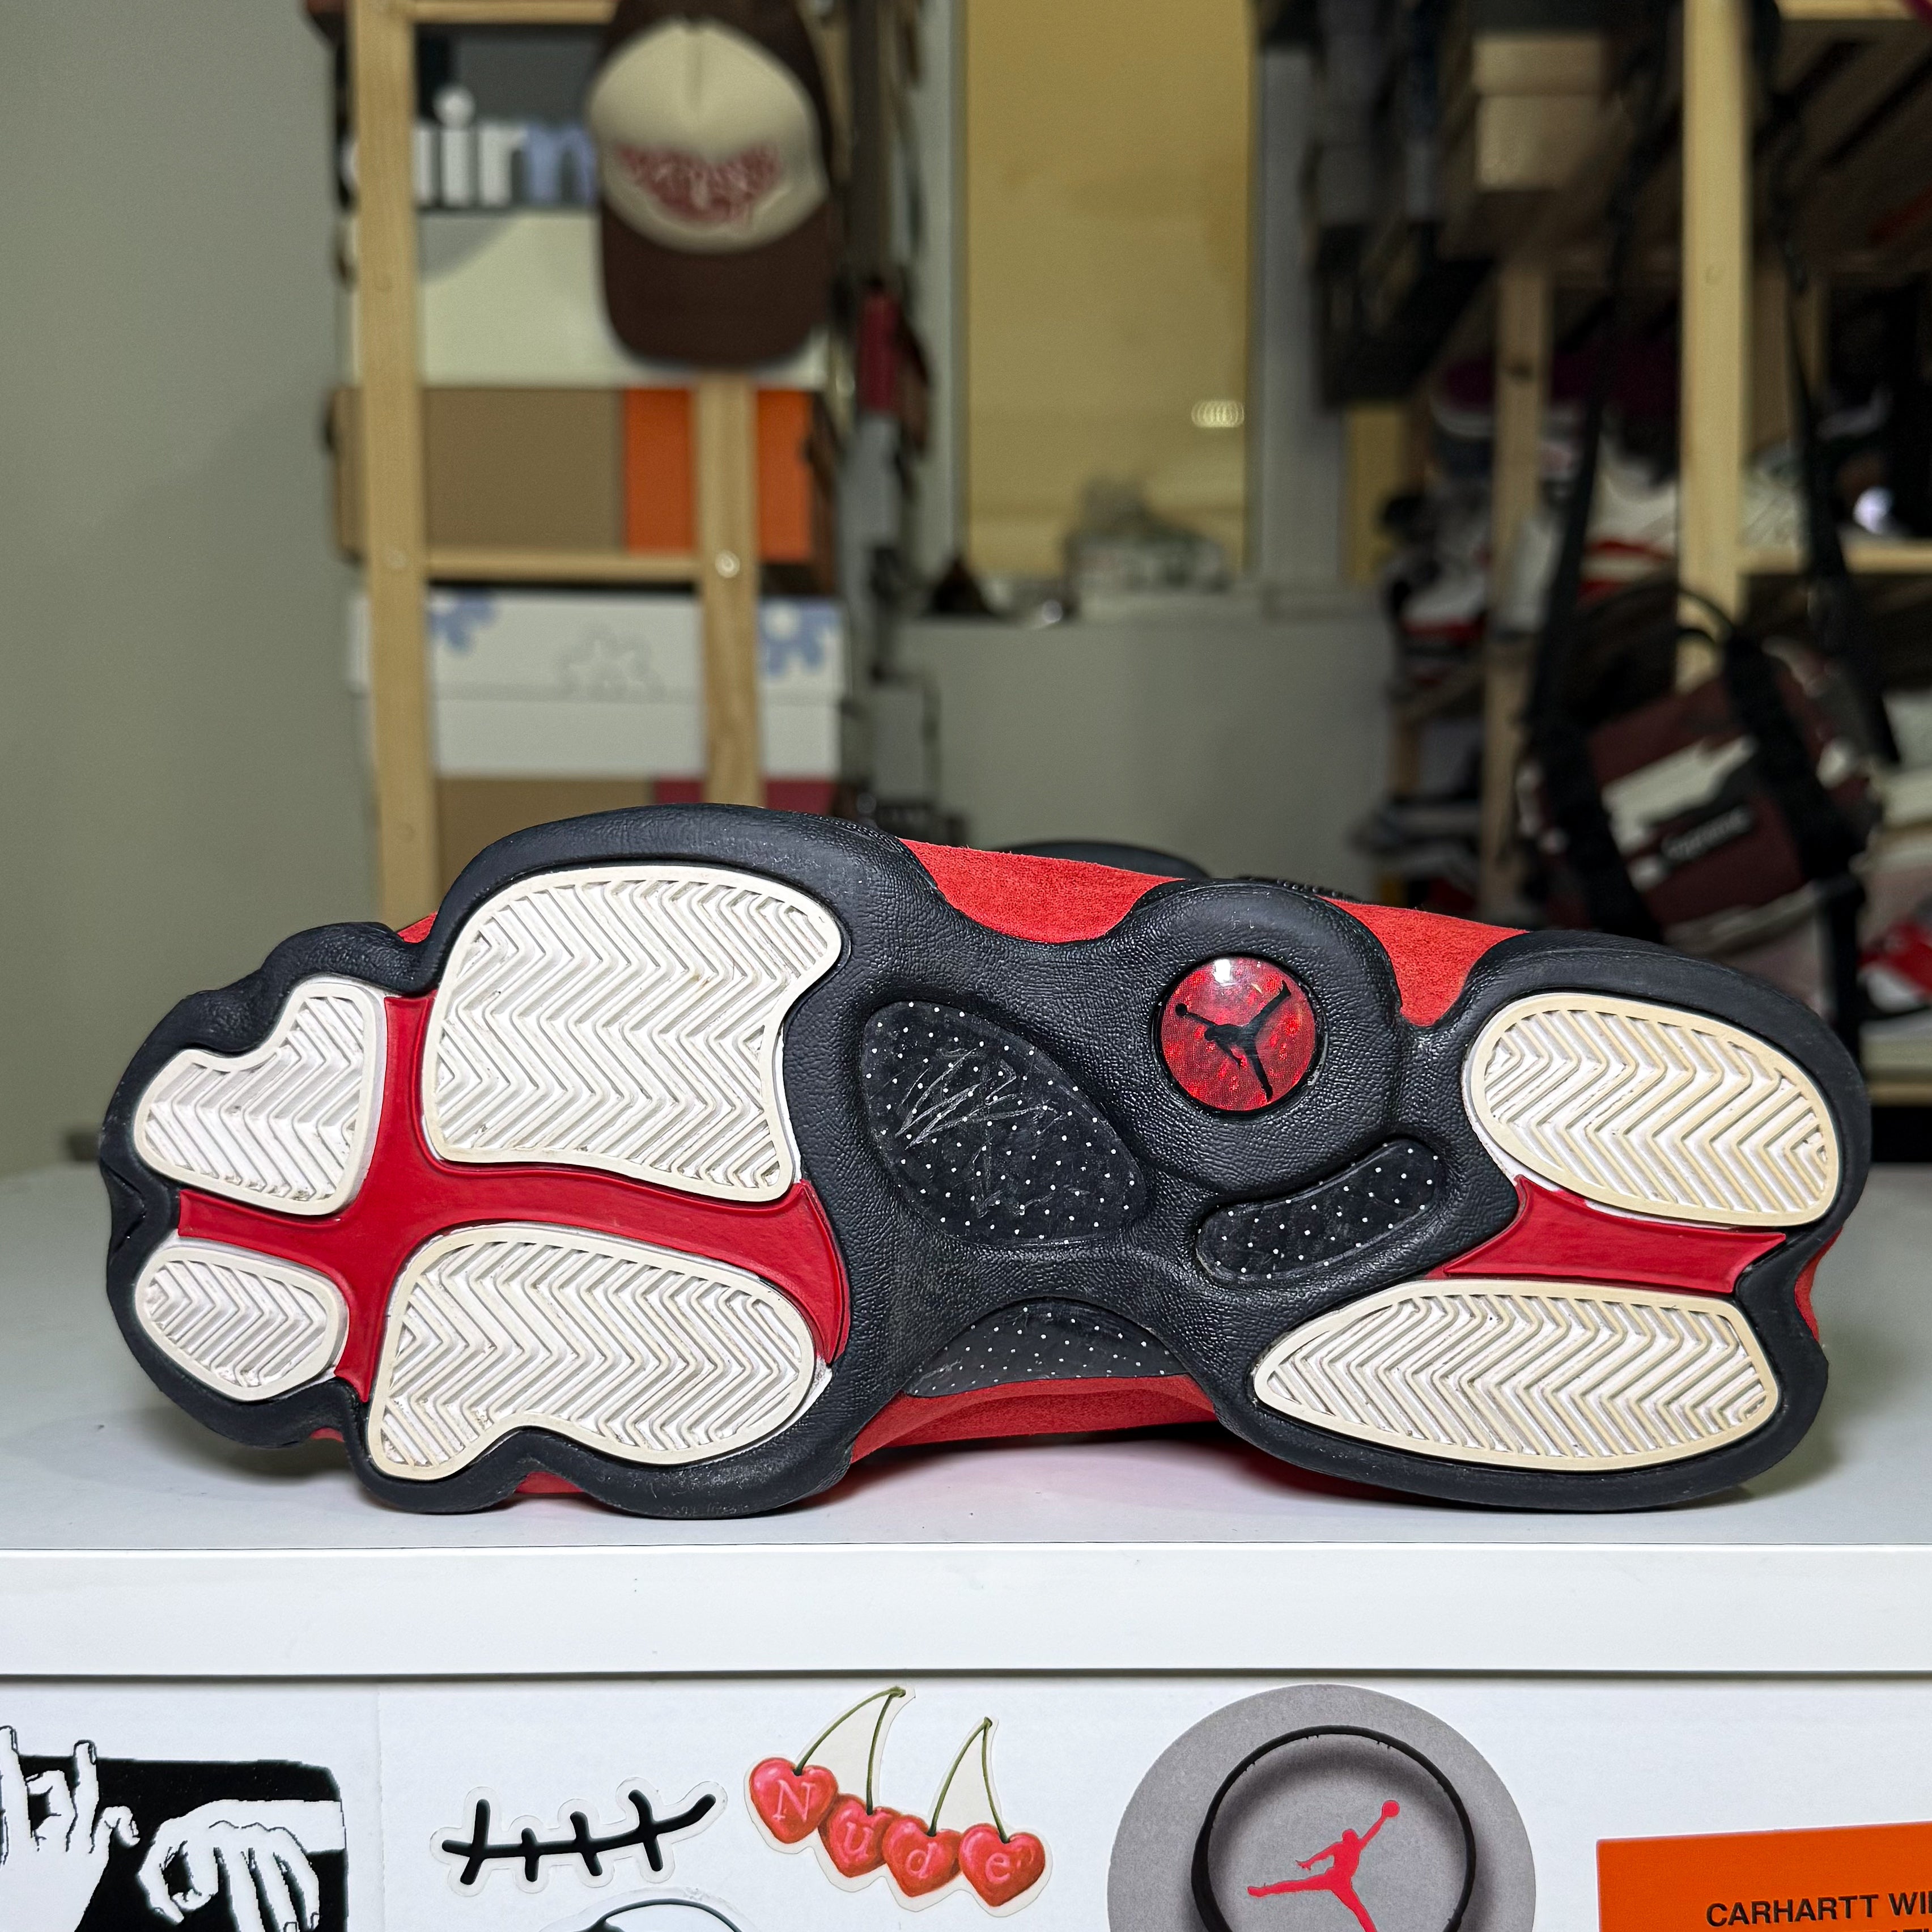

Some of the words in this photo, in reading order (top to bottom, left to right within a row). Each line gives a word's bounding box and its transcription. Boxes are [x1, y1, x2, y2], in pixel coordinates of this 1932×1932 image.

[772, 1779, 1011, 1884] Nude
[1706, 1894, 1879, 1927] CARHARTT
[1888, 1891, 1932, 1916] WI
